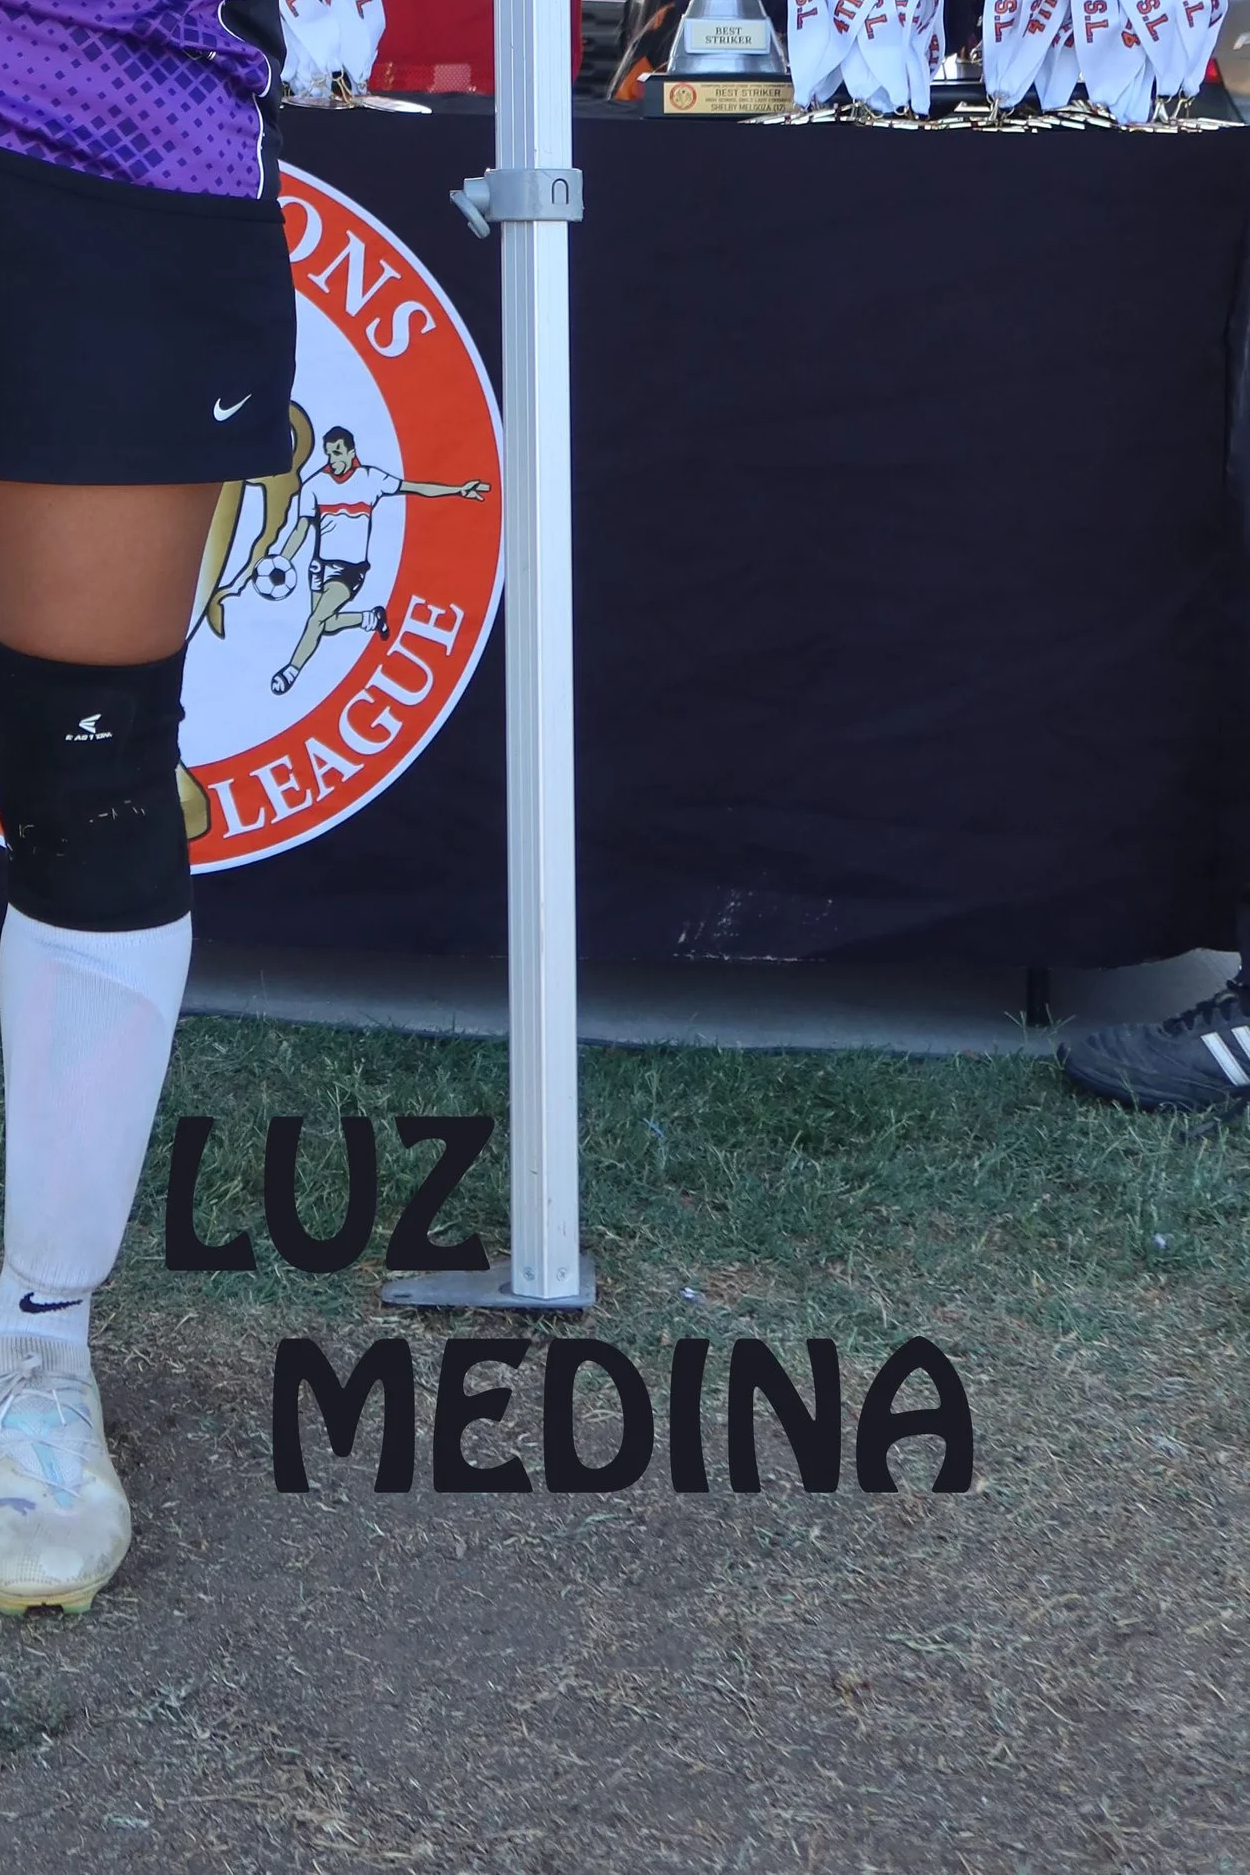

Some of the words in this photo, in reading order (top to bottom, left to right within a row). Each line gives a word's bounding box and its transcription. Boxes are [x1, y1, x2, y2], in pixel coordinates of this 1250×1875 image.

[715, 27, 742, 35] BEST
[705, 36, 752, 44] STRIKER
[715, 88, 738, 97] BEST
[741, 88, 781, 97] STRIKER
[209, 593, 467, 839] LEAGUE
